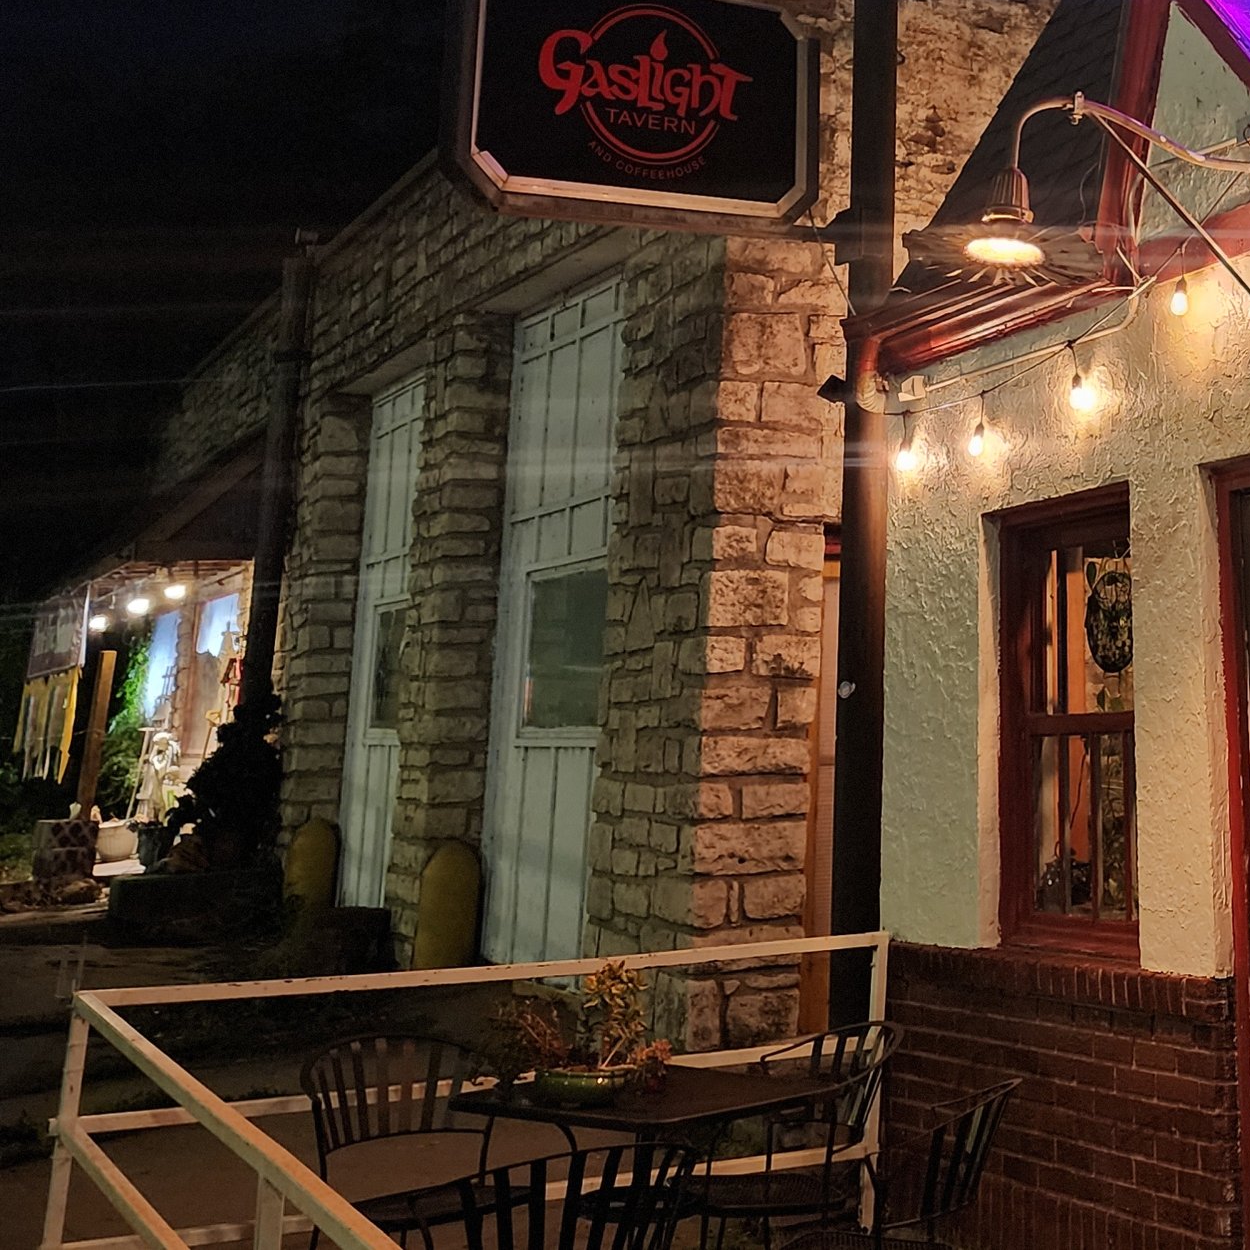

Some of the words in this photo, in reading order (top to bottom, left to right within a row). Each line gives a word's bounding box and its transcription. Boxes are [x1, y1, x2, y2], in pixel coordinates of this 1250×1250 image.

[604, 107, 697, 136] TAVERN
[587, 140, 612, 164] AND
[616, 156, 707, 180] COFFEEHOUSE
